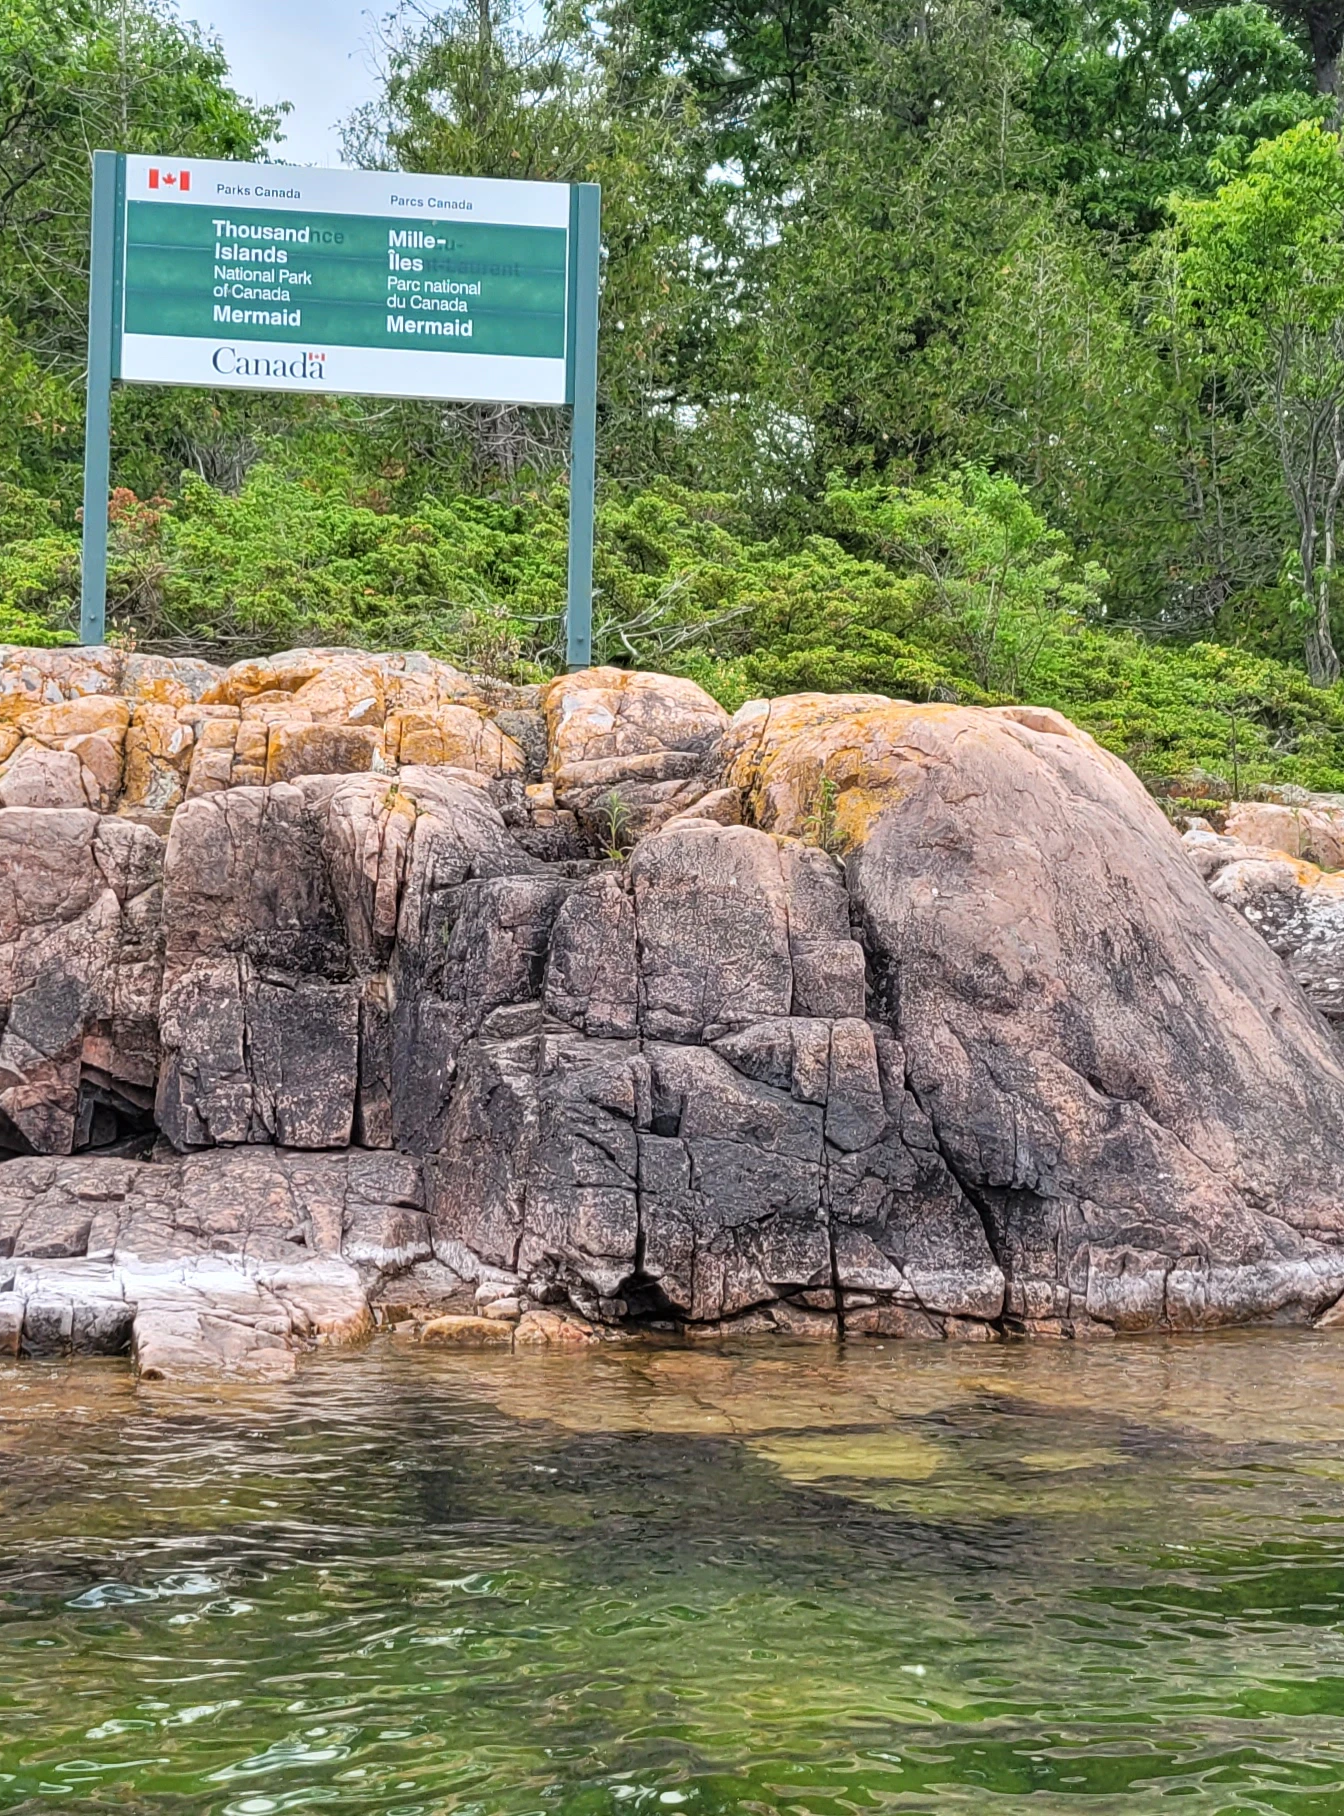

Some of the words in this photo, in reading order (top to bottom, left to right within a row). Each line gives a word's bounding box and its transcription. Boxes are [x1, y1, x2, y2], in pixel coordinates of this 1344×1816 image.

[217, 183, 251, 196] Parks
[254, 186, 301, 199] Canada
[390, 195, 424, 207] Parcs
[427, 197, 473, 210] Canada
[212, 219, 310, 243] Thousand
[388, 229, 446, 249] Mille-
[215, 242, 288, 263] Islands
[388, 248, 424, 271] Îles
[214, 265, 275, 283] National
[279, 269, 312, 285] Park
[387, 275, 421, 292] Parc
[424, 279, 481, 296] national
[213, 283, 229, 298] of
[231, 284, 290, 302] Canada
[387, 293, 406, 309] du
[410, 295, 468, 312] Canada
[213, 304, 301, 326] Mermaid
[386, 314, 473, 337] Mermaid
[212, 346, 326, 380] Canada
